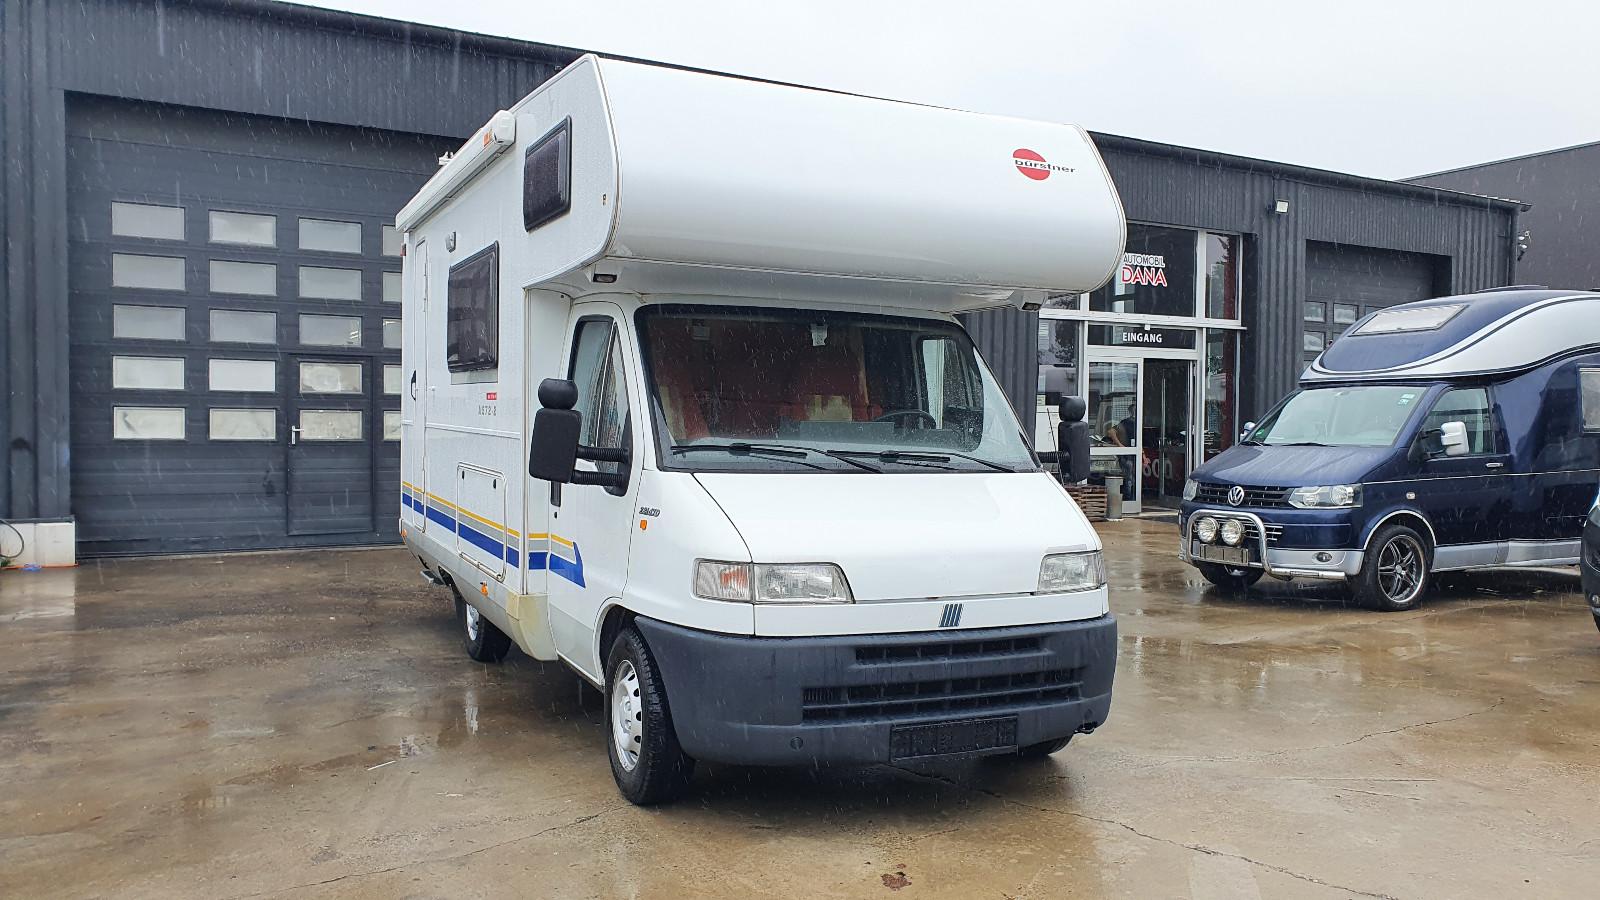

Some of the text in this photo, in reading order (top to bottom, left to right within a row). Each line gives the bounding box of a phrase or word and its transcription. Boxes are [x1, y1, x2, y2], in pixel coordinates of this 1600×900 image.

[1123, 252, 1165, 268] AUTOMOBIL
[1122, 265, 1167, 287] DANA
[1122, 332, 1162, 343] EINGANG
